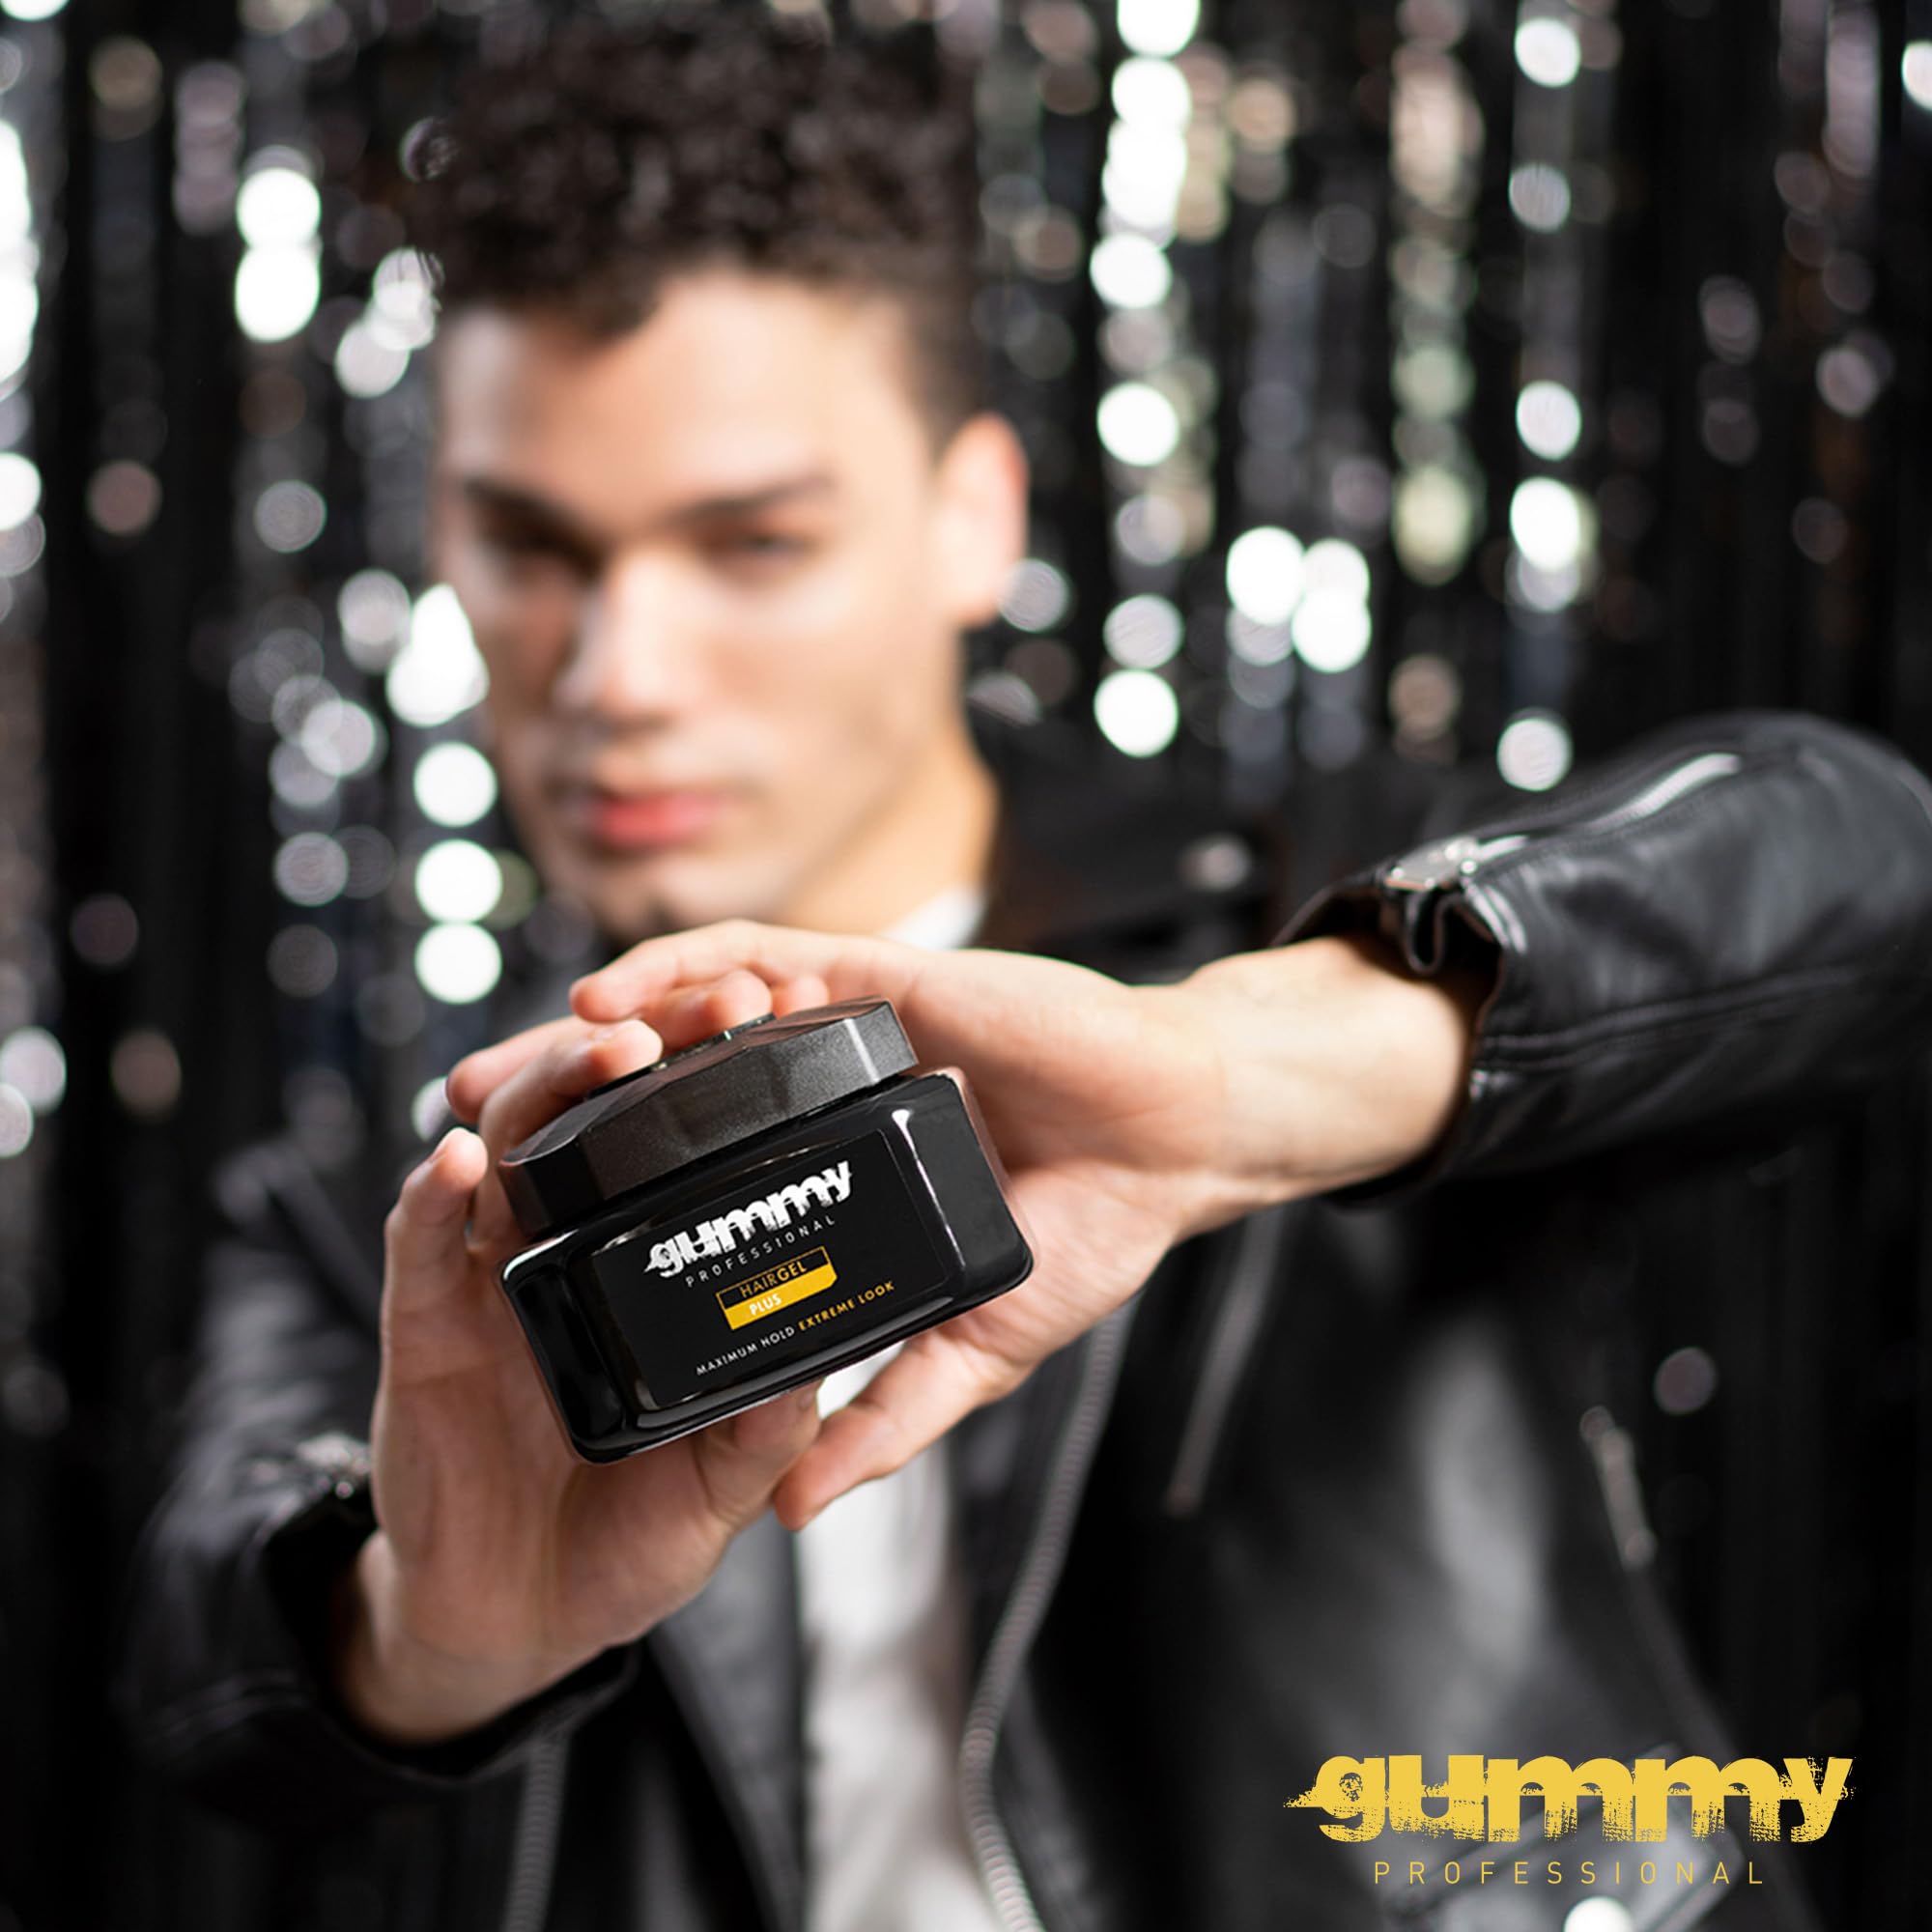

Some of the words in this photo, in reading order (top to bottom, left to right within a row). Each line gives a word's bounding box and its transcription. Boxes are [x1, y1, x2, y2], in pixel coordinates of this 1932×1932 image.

[644, 1160, 852, 1278] gummy
[685, 1215, 836, 1288] PROFESSIONAL
[696, 1343, 758, 1377] MAXIMUM
[760, 1326, 796, 1349] HOLD
[798, 1299, 856, 1331] EXTREME
[857, 1280, 895, 1304] LOOK
[749, 1293, 782, 1316] PLUS
